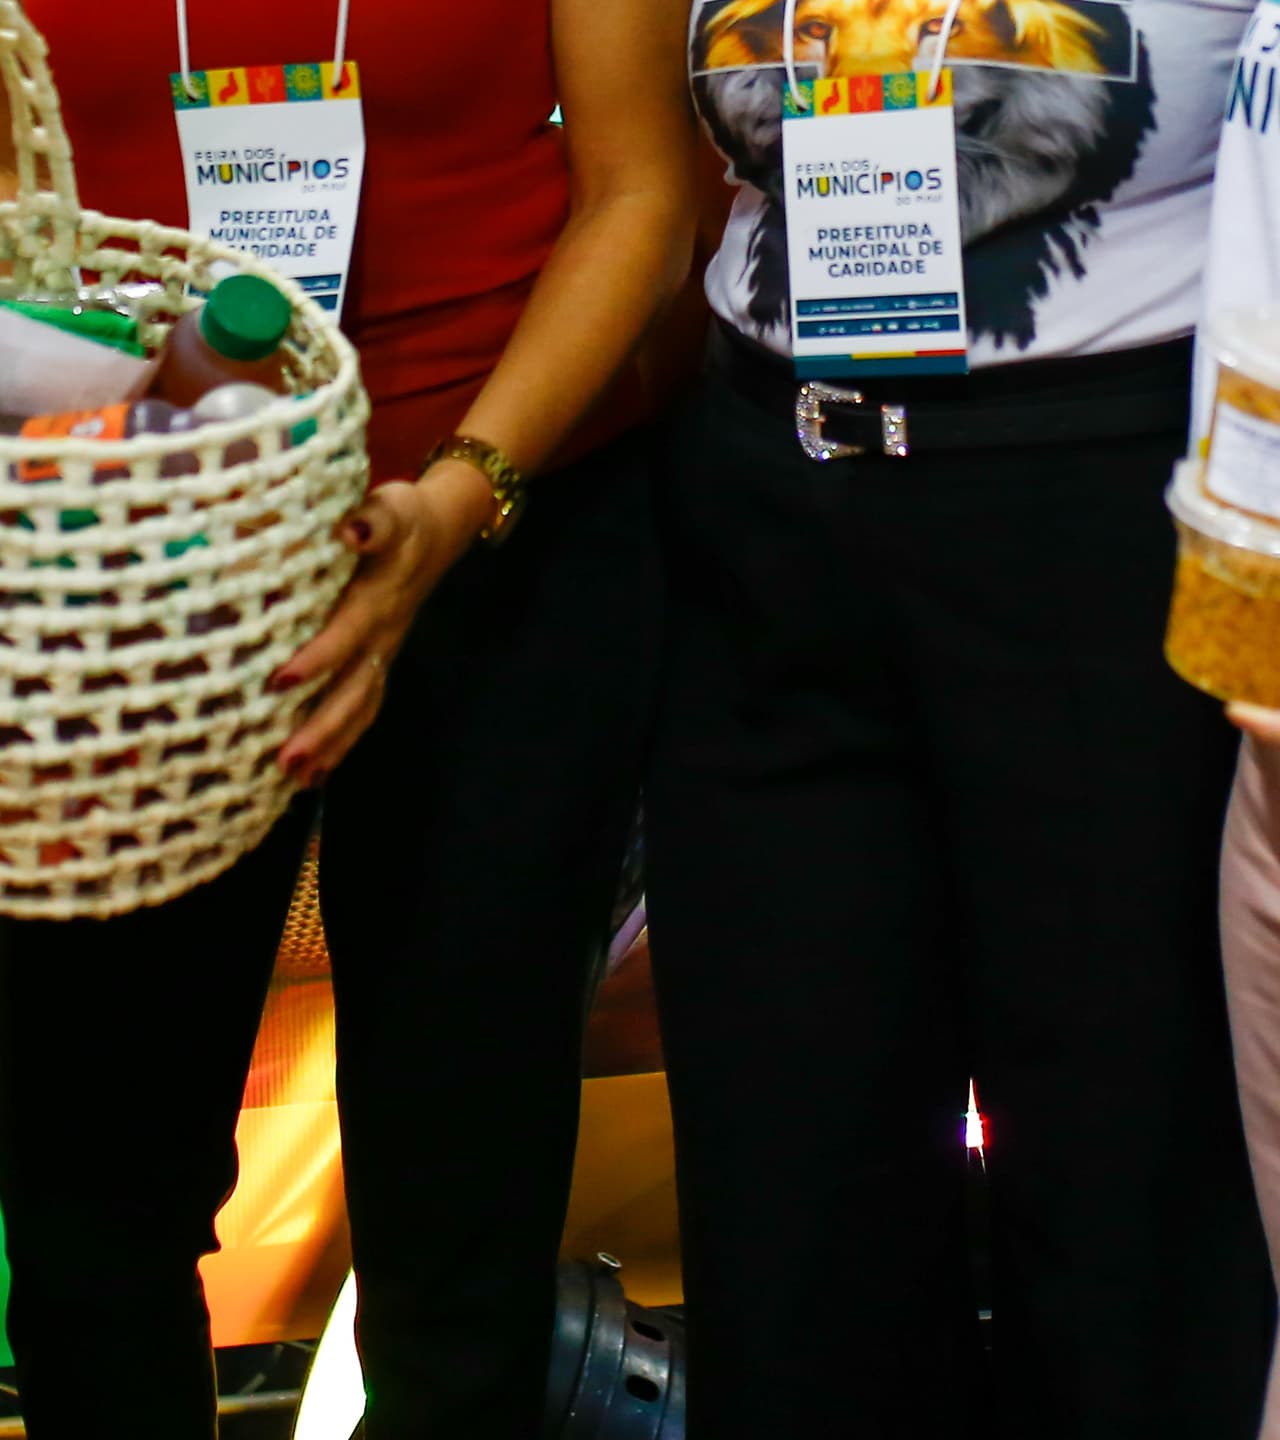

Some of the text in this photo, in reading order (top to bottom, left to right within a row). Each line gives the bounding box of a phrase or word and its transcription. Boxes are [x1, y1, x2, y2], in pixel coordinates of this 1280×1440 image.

[244, 148, 275, 160] DOS
[197, 153, 350, 185] MUNICÍPIOS
[796, 160, 869, 174] FEIRA DOS
[797, 165, 942, 200] MUNICÍPIOS
[220, 209, 331, 225] PREFEITURA
[209, 225, 337, 241] MUNICIPAL DE
[817, 223, 932, 243] PREFEITURA
[808, 241, 943, 260] MUNICIPAL DE
[828, 260, 926, 278] CARIDADE
